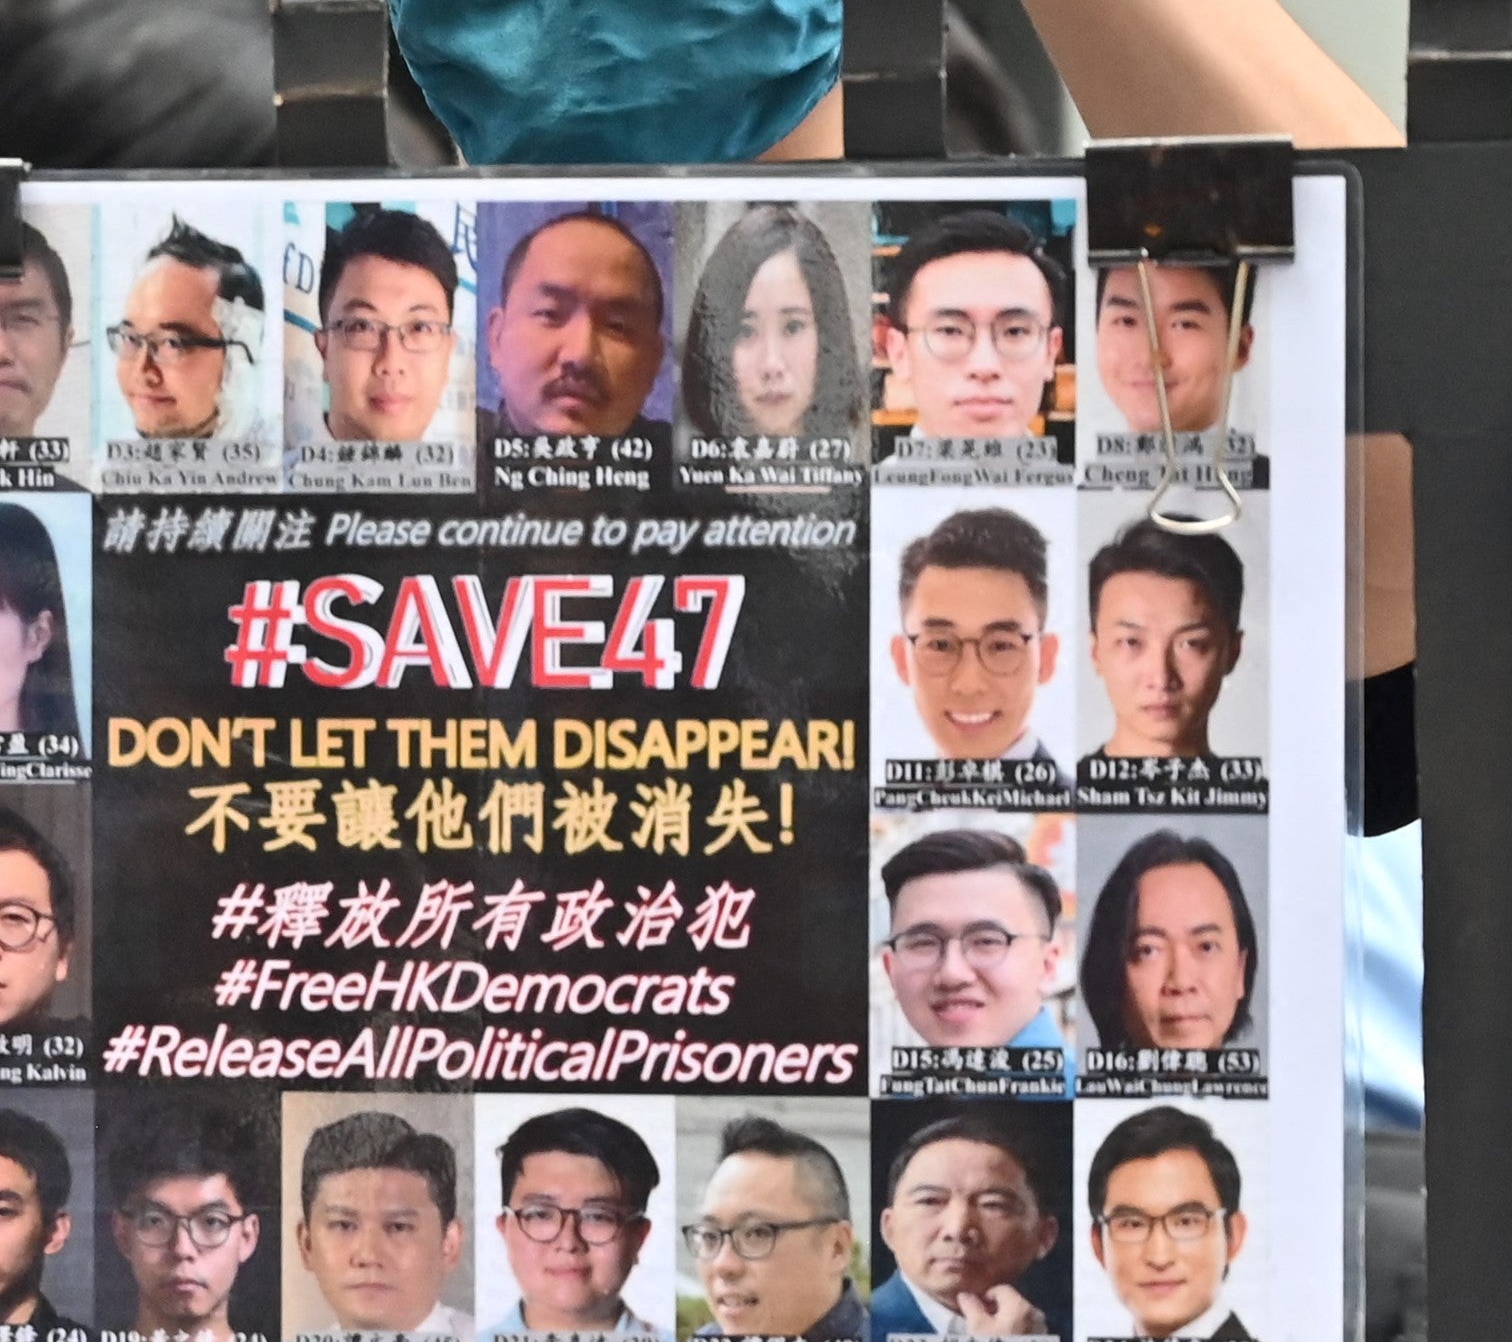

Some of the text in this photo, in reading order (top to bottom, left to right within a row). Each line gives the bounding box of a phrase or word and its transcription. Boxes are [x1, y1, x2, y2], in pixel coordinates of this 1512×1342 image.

[612, 438, 652, 460] (42)
[18, 470, 54, 488] Hin
[495, 466, 650, 490] Ng Ching Heng
[326, 514, 430, 547] Please
[438, 515, 582, 548] continue
[592, 519, 621, 547] to
[631, 521, 696, 555] pay
[703, 517, 856, 548] attention
[225, 573, 746, 690] #SAVE47
[39, 735, 78, 756] (34)
[107, 717, 855, 769] DON'T LET THEM DISAPPEAR!
[211, 879, 756, 951] #釋放所有政治犯
[215, 960, 735, 1015] #FreeHKDemocrats
[43, 1035, 84, 1058] (32)
[102, 1024, 860, 1085] #ReleaseAllPoliticalPrisoners
[27, 1064, 87, 1082] Kalvin
